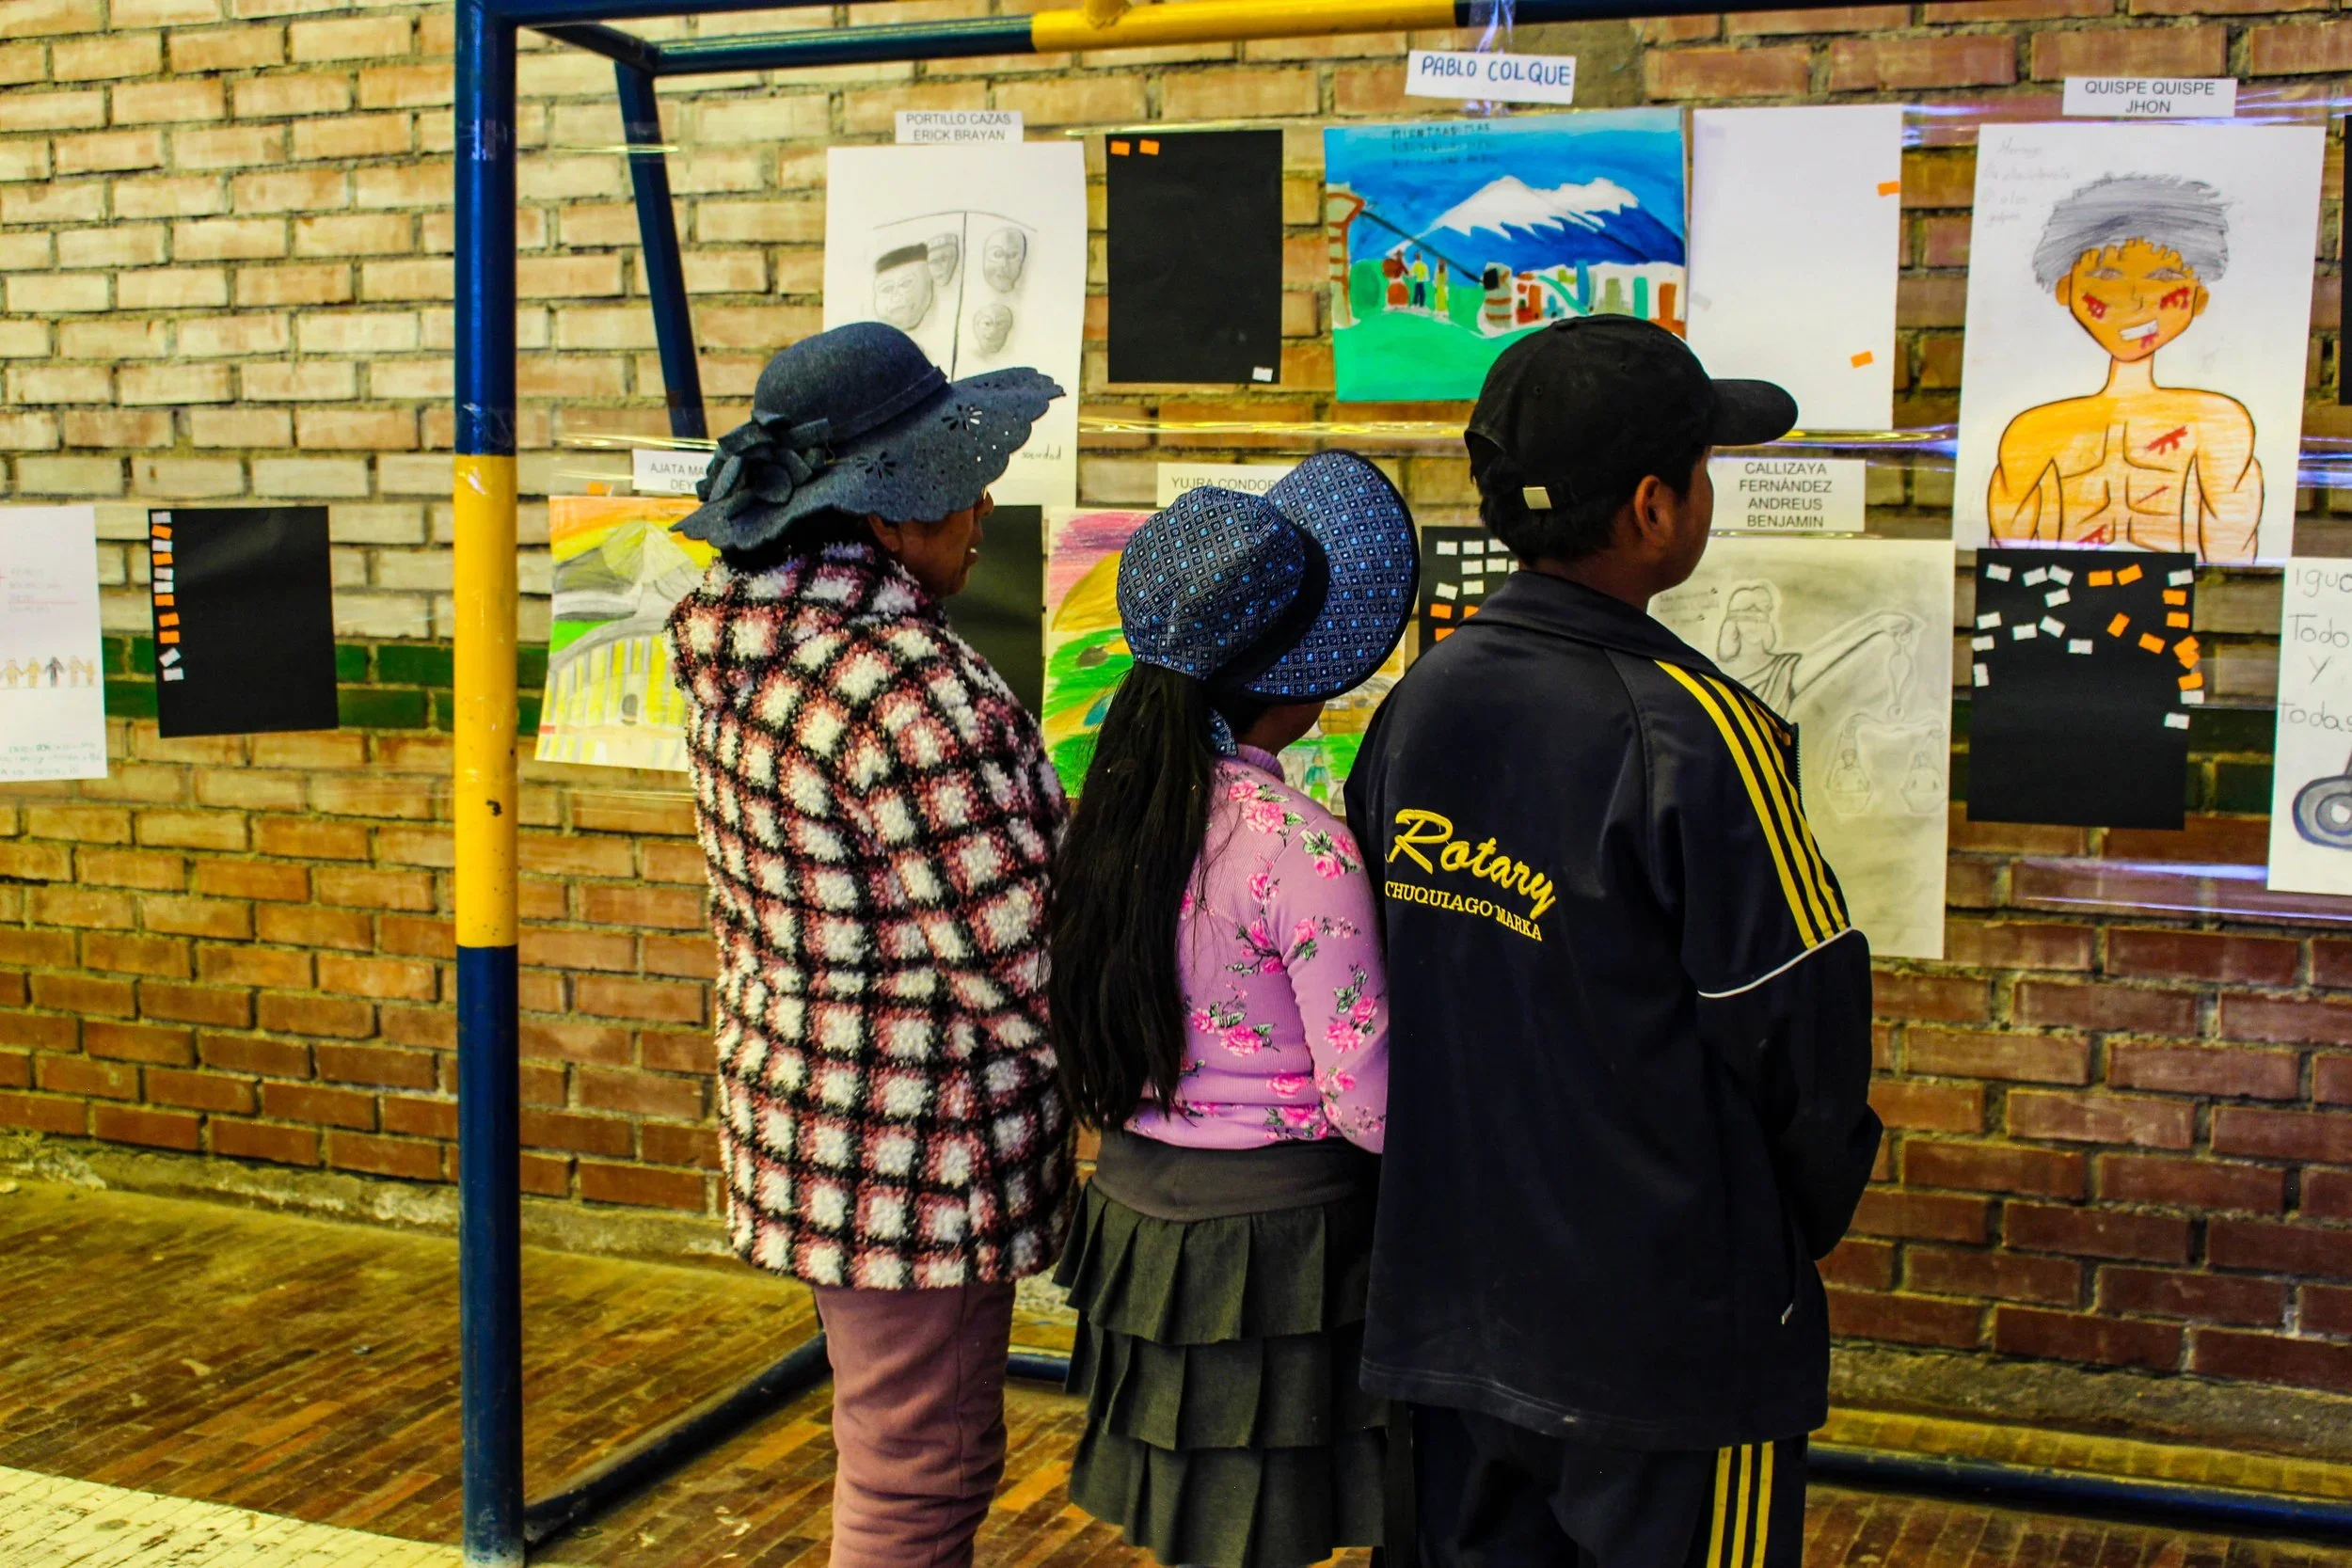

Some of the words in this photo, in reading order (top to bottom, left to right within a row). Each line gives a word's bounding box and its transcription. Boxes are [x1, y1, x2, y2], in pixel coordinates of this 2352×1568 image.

[1421, 55, 1477, 77] PABLO
[1487, 59, 1571, 87] COLQUE
[2084, 80, 2148, 95] QUISPE
[2152, 81, 2216, 96] QUISPE
[2124, 99, 2171, 114] JHON
[905, 112, 967, 126] PORTILLO
[913, 130, 951, 142] ERICK
[954, 130, 1007, 141] BRAYAN
[650, 462, 686, 474] AJATA
[1744, 461, 1828, 475] CALLIZAYA
[1171, 477, 1214, 489] YUJRA
[1739, 477, 1833, 494] FERNÁNDEZ
[1747, 497, 1823, 511] ANDREUS
[1746, 514, 1824, 529] BENJAMIN
[1386, 808, 1557, 921] Rotary
[1384, 879, 1494, 917] CHUQUIAGO
[1494, 904, 1543, 942] MARKA
